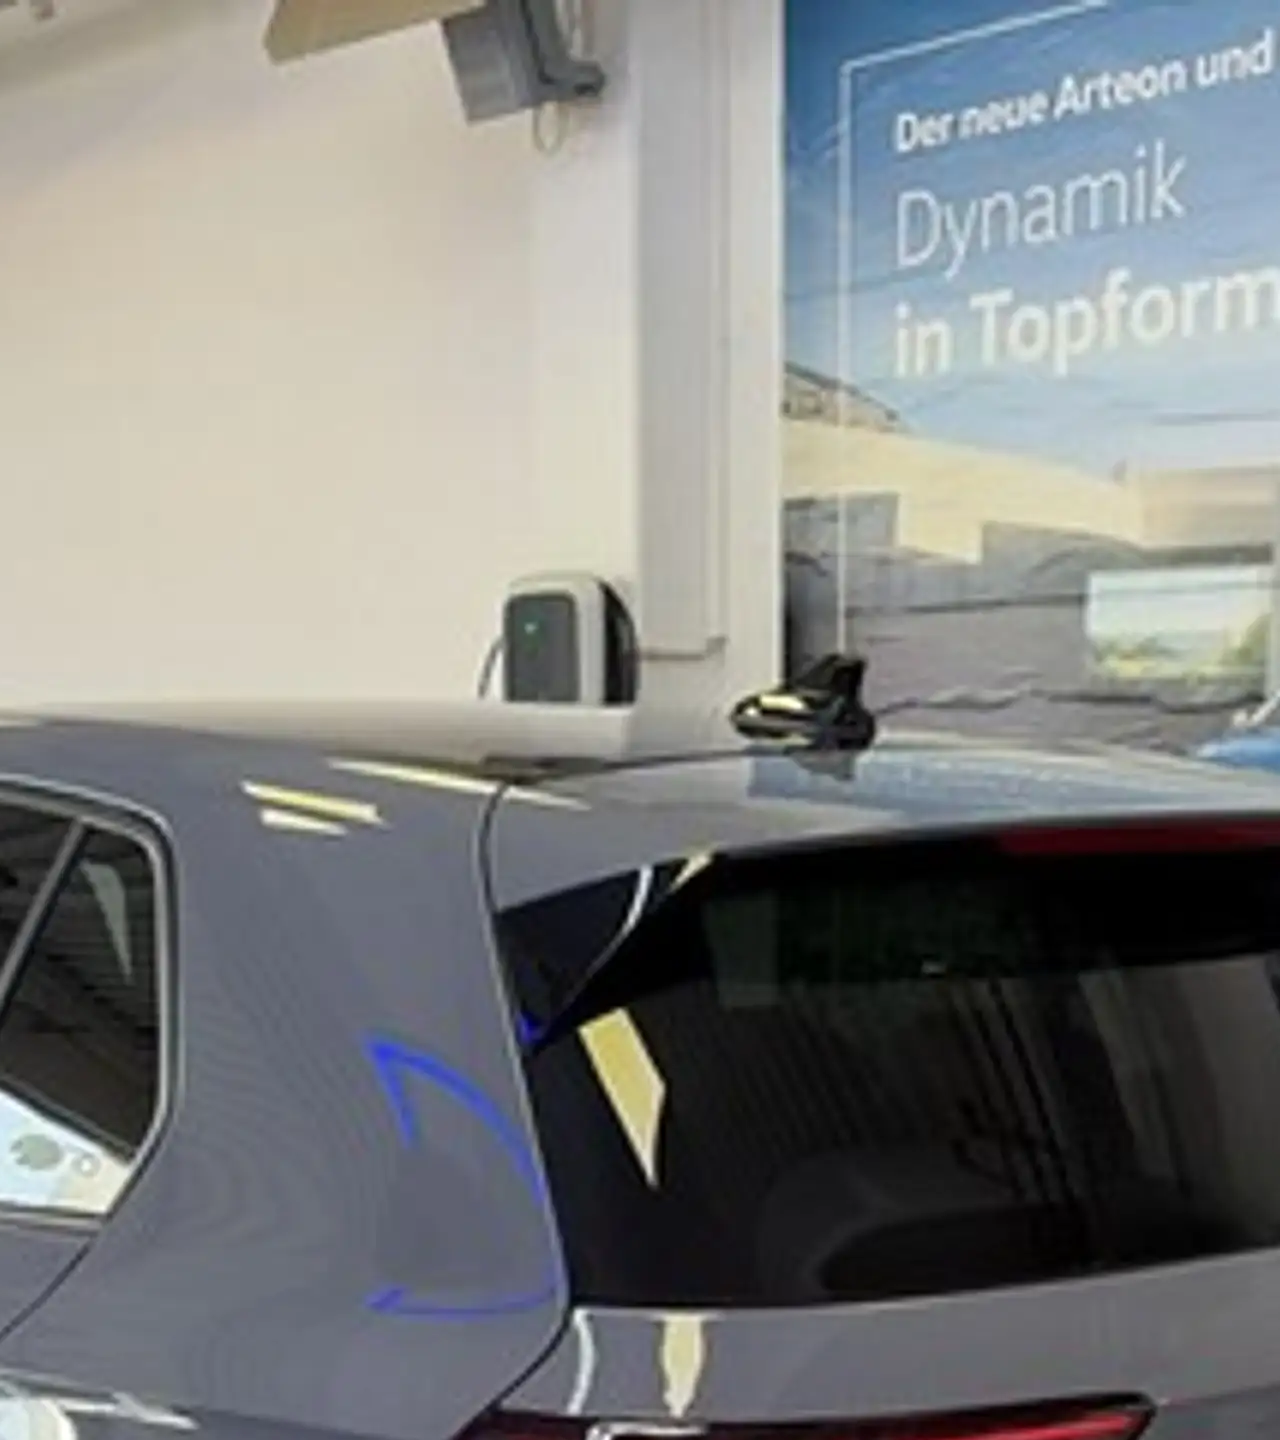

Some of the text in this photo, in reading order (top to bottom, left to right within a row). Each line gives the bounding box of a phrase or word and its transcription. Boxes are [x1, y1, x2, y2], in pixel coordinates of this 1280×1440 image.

[895, 109, 953, 153] Der
[959, 95, 1048, 138] neue
[1053, 57, 1190, 119] Arteon
[1197, 46, 1276, 89] und
[897, 142, 1190, 277] Dynamik
[895, 305, 951, 376] in
